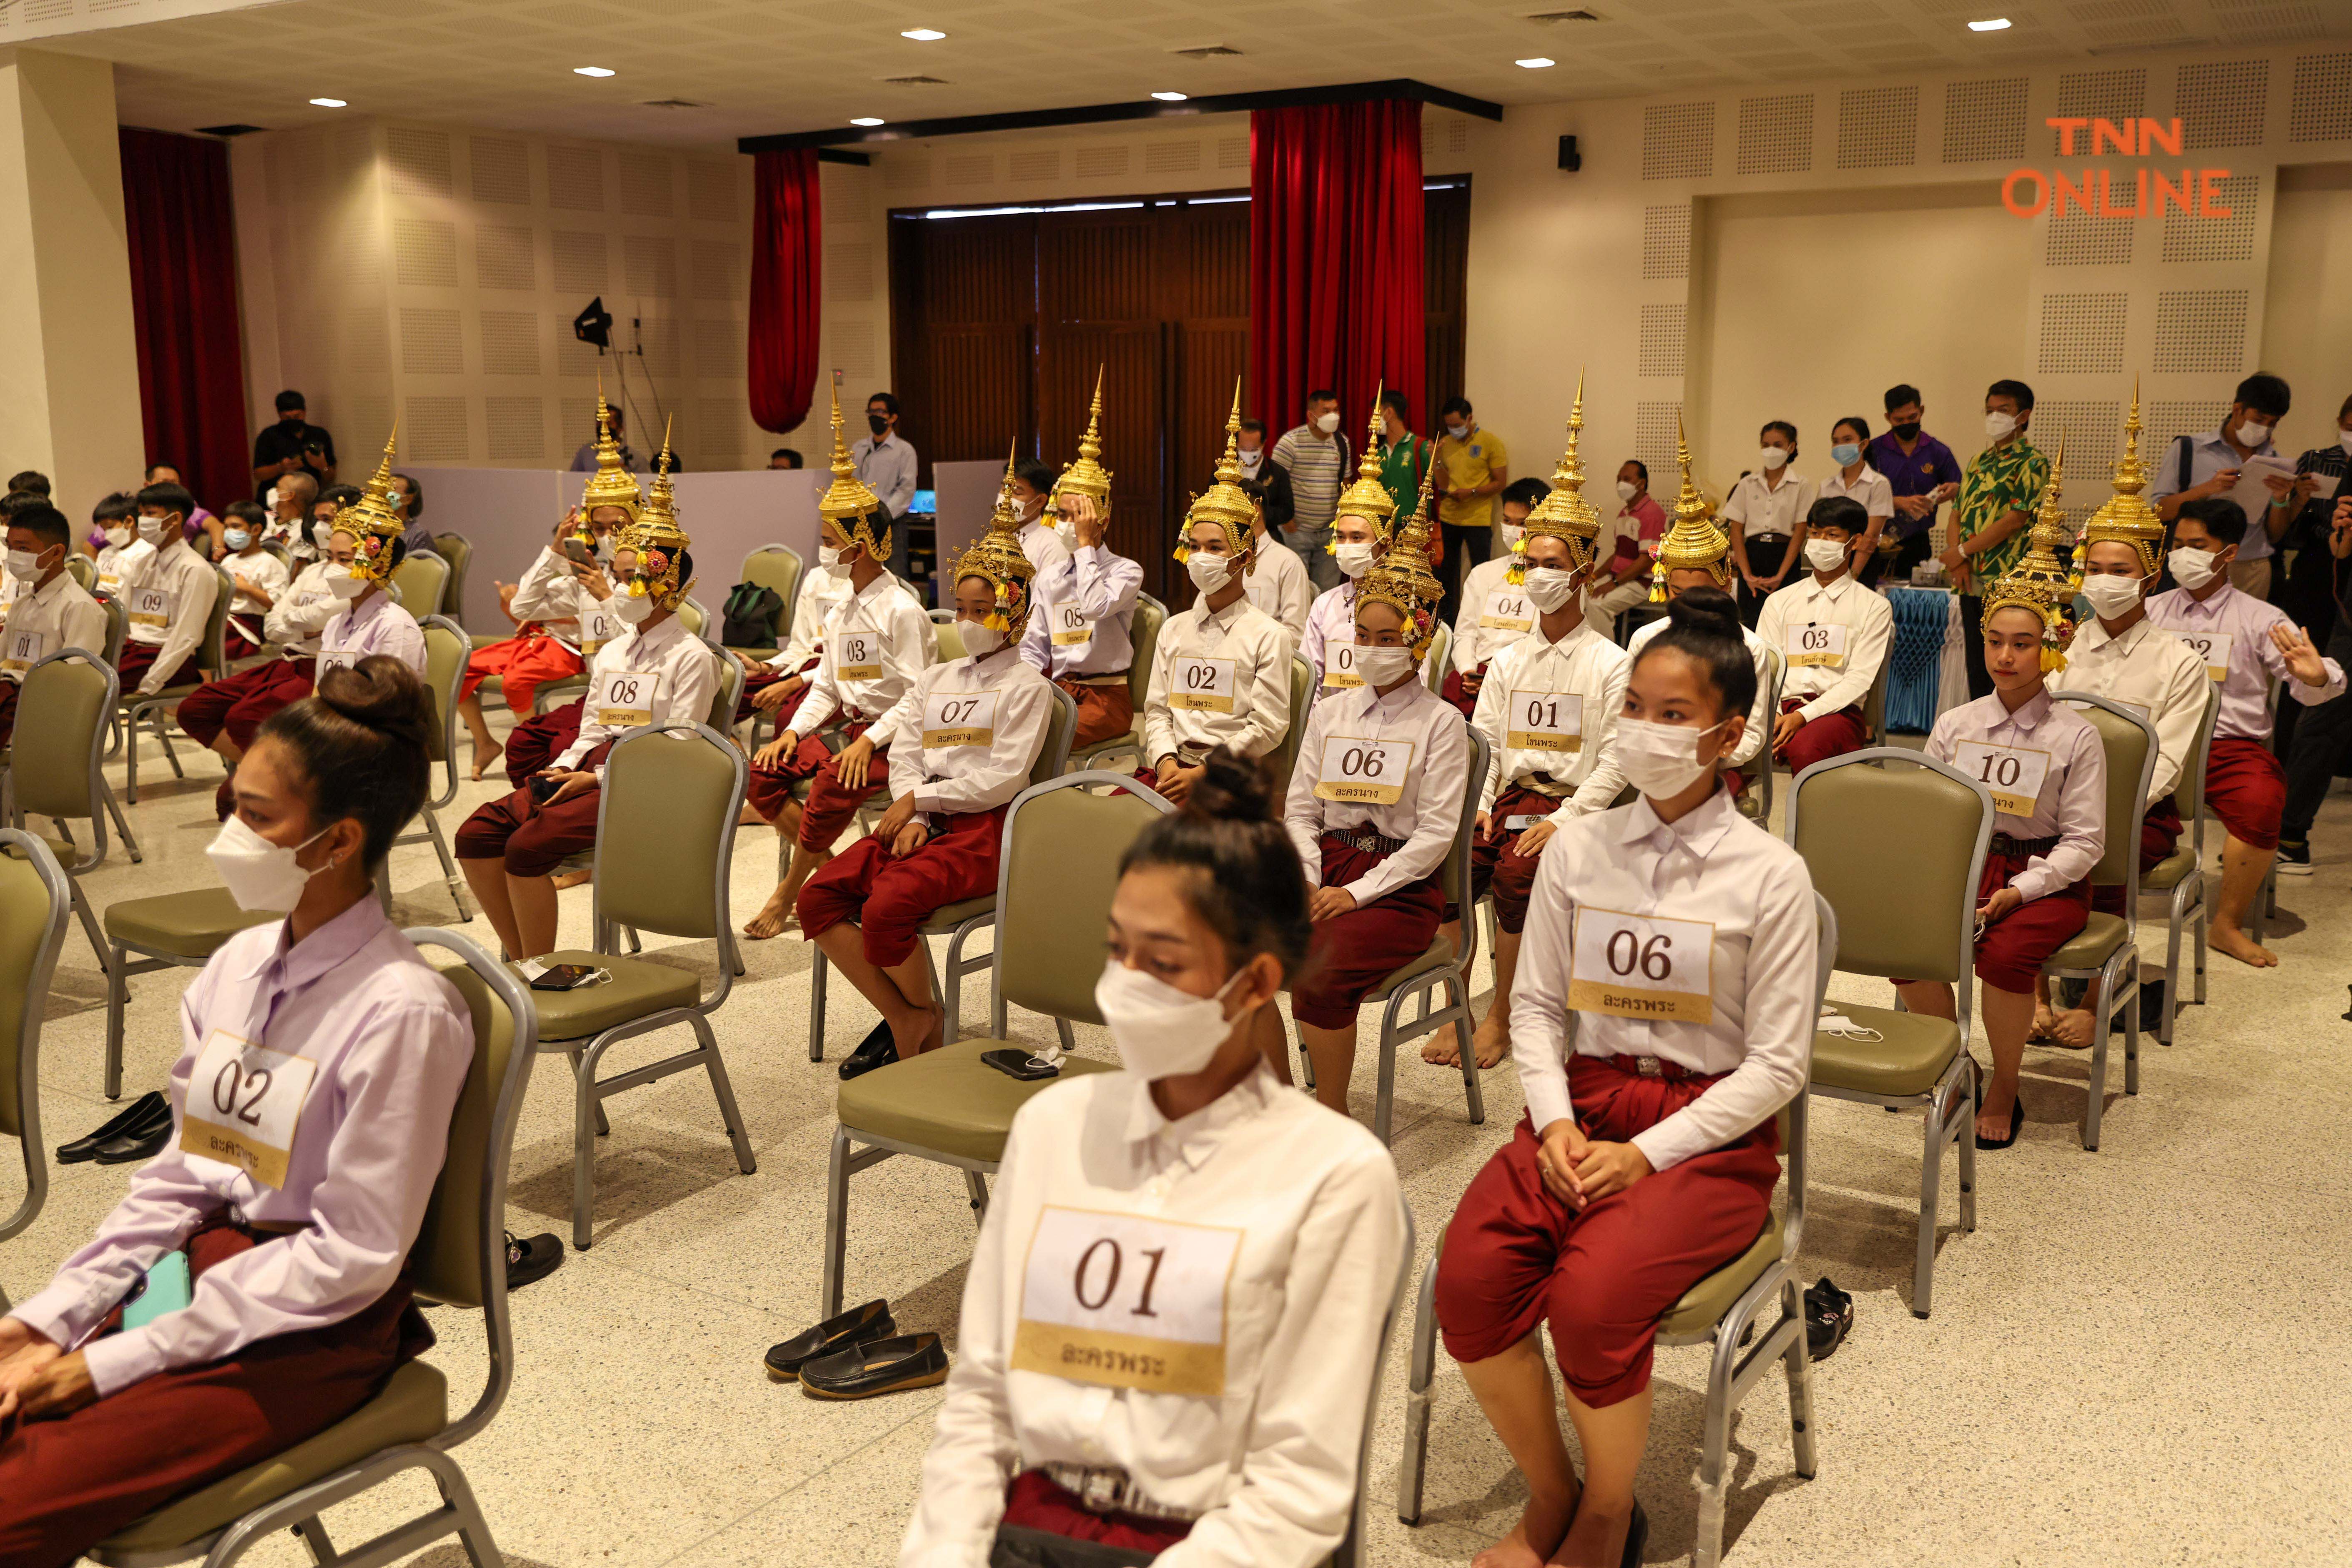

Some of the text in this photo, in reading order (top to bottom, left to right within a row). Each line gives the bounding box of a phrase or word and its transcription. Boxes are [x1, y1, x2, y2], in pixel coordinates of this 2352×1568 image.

[143, 594, 161, 612] 09
[1498, 598, 1523, 616] 04
[1065, 608, 1084, 627] 08
[18, 637, 30, 657] 01
[847, 640, 866, 662] 03
[1802, 630, 1828, 650] 03
[1187, 665, 1216, 690] 02
[611, 680, 638, 703] 08
[1186, 695, 1212, 707] โขนพระ
[941, 700, 979, 723] 07
[1528, 701, 1558, 728] 01
[937, 733, 971, 743] ละครนาง
[1526, 734, 1558, 747] โขนพระ
[1342, 748, 1386, 777] 06
[1978, 755, 2020, 786] 10
[1335, 788, 1378, 798] ละครนาง
[1606, 930, 1672, 980] 06
[1604, 994, 1675, 1012] ละครพระ
[213, 1059, 273, 1126] 02
[1074, 1237, 1166, 1317] 01
[1062, 1343, 1166, 1377] ละครพระ
